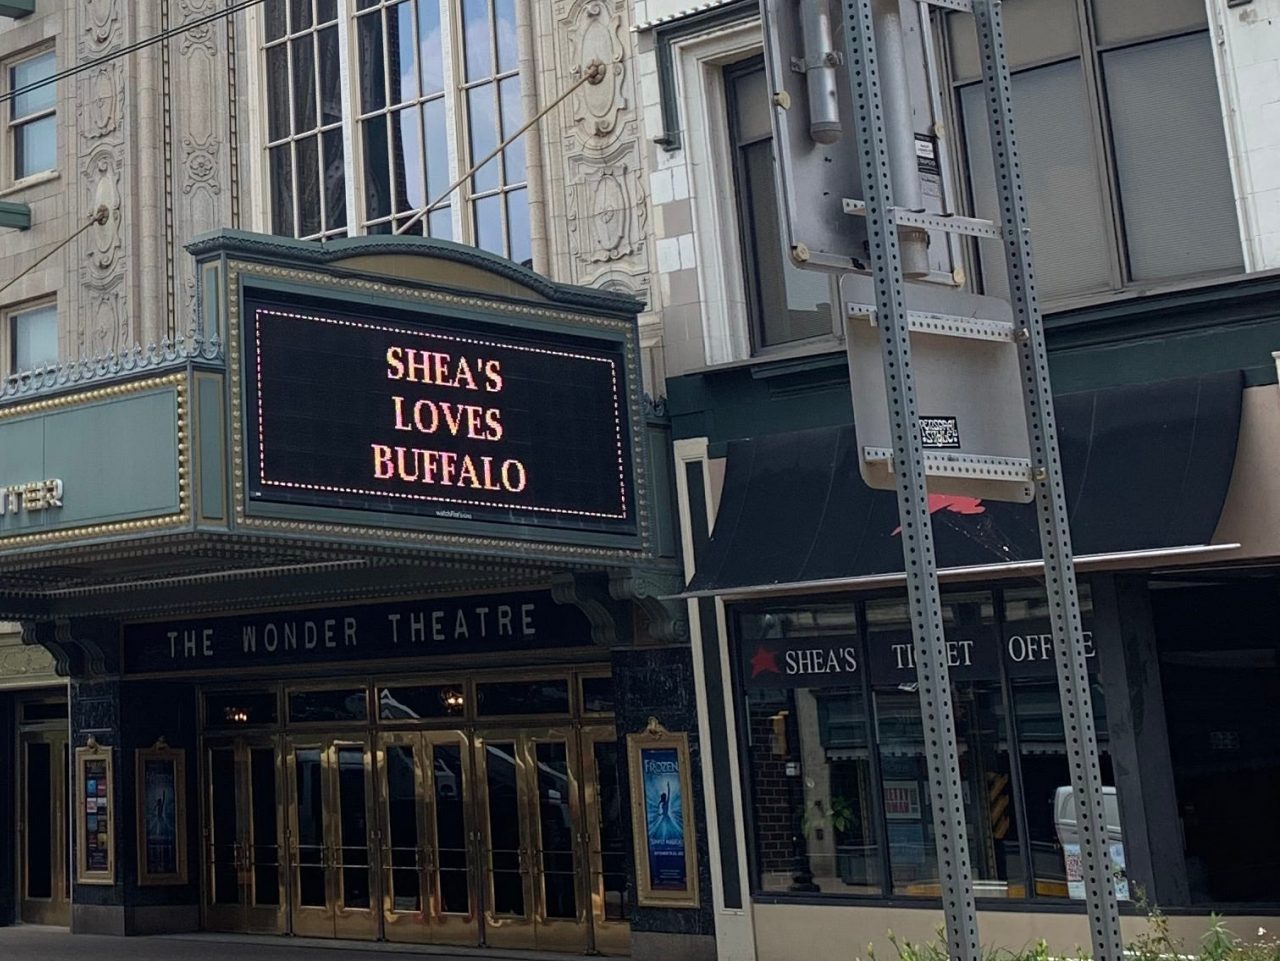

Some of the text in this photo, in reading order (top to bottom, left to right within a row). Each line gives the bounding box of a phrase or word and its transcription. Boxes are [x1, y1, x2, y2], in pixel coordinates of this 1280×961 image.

[386, 345, 503, 393] SHEA'S
[392, 396, 503, 441] LOVES
[371, 443, 527, 493] BUFFALO
[166, 603, 537, 659] THE WONDER THEATRE
[785, 631, 1096, 675] SHEA'S TIET OFFE
[644, 759, 680, 775] FROZEN
